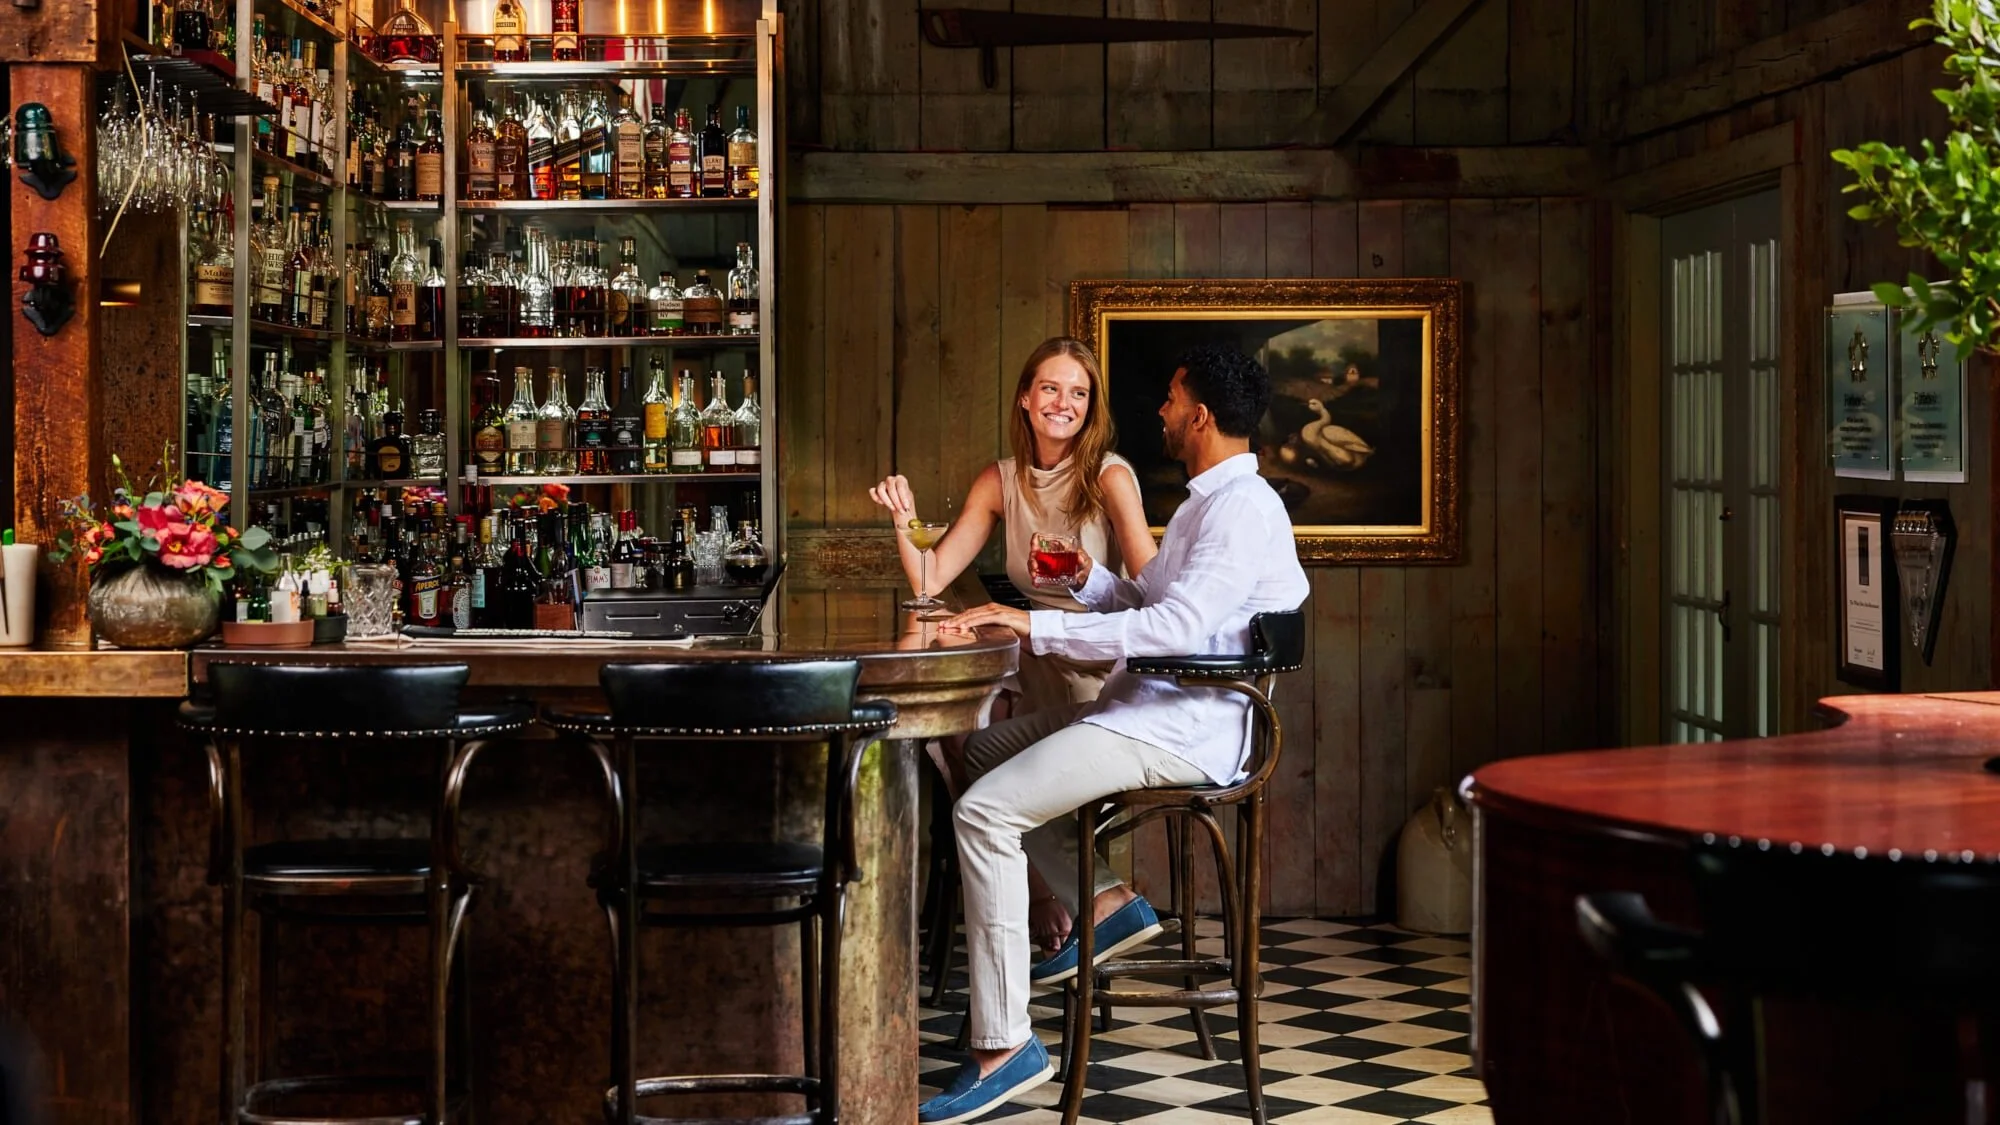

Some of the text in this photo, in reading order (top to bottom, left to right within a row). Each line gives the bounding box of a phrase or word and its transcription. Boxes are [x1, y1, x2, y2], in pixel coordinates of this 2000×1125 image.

[268, 253, 284, 261] HIG
[586, 574, 609, 584] PIMM'S
[415, 579, 440, 591] APEROL
